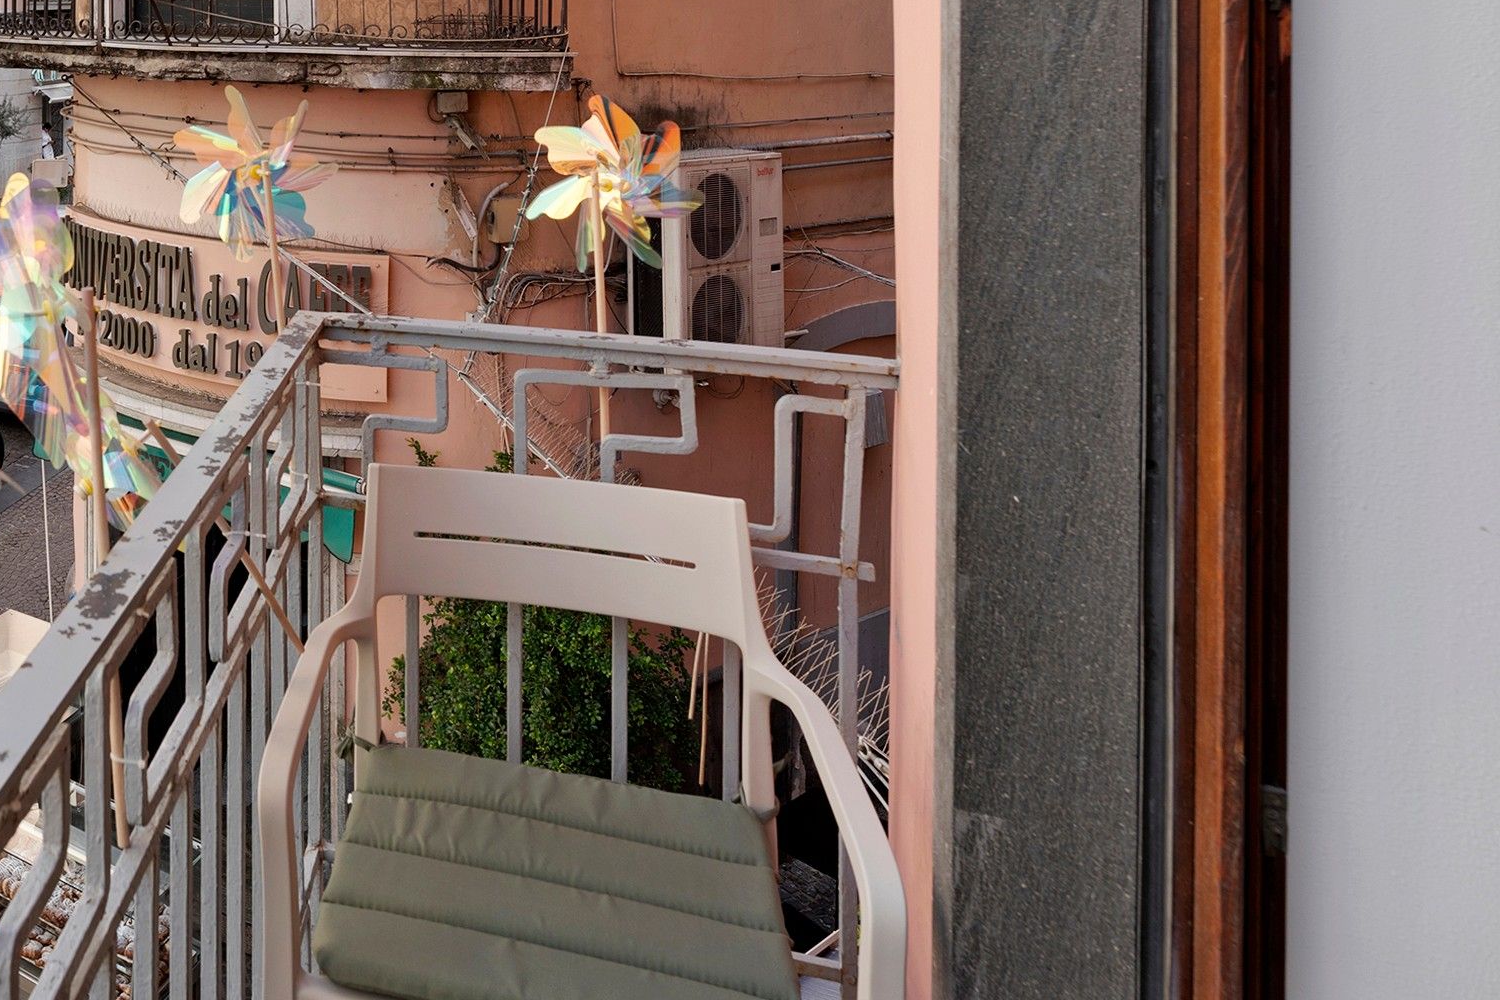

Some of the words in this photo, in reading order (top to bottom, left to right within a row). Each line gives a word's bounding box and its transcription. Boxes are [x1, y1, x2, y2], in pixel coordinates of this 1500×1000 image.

[202, 274, 249, 331] del
[99, 309, 156, 359] 2000
[172, 328, 218, 374] dal
